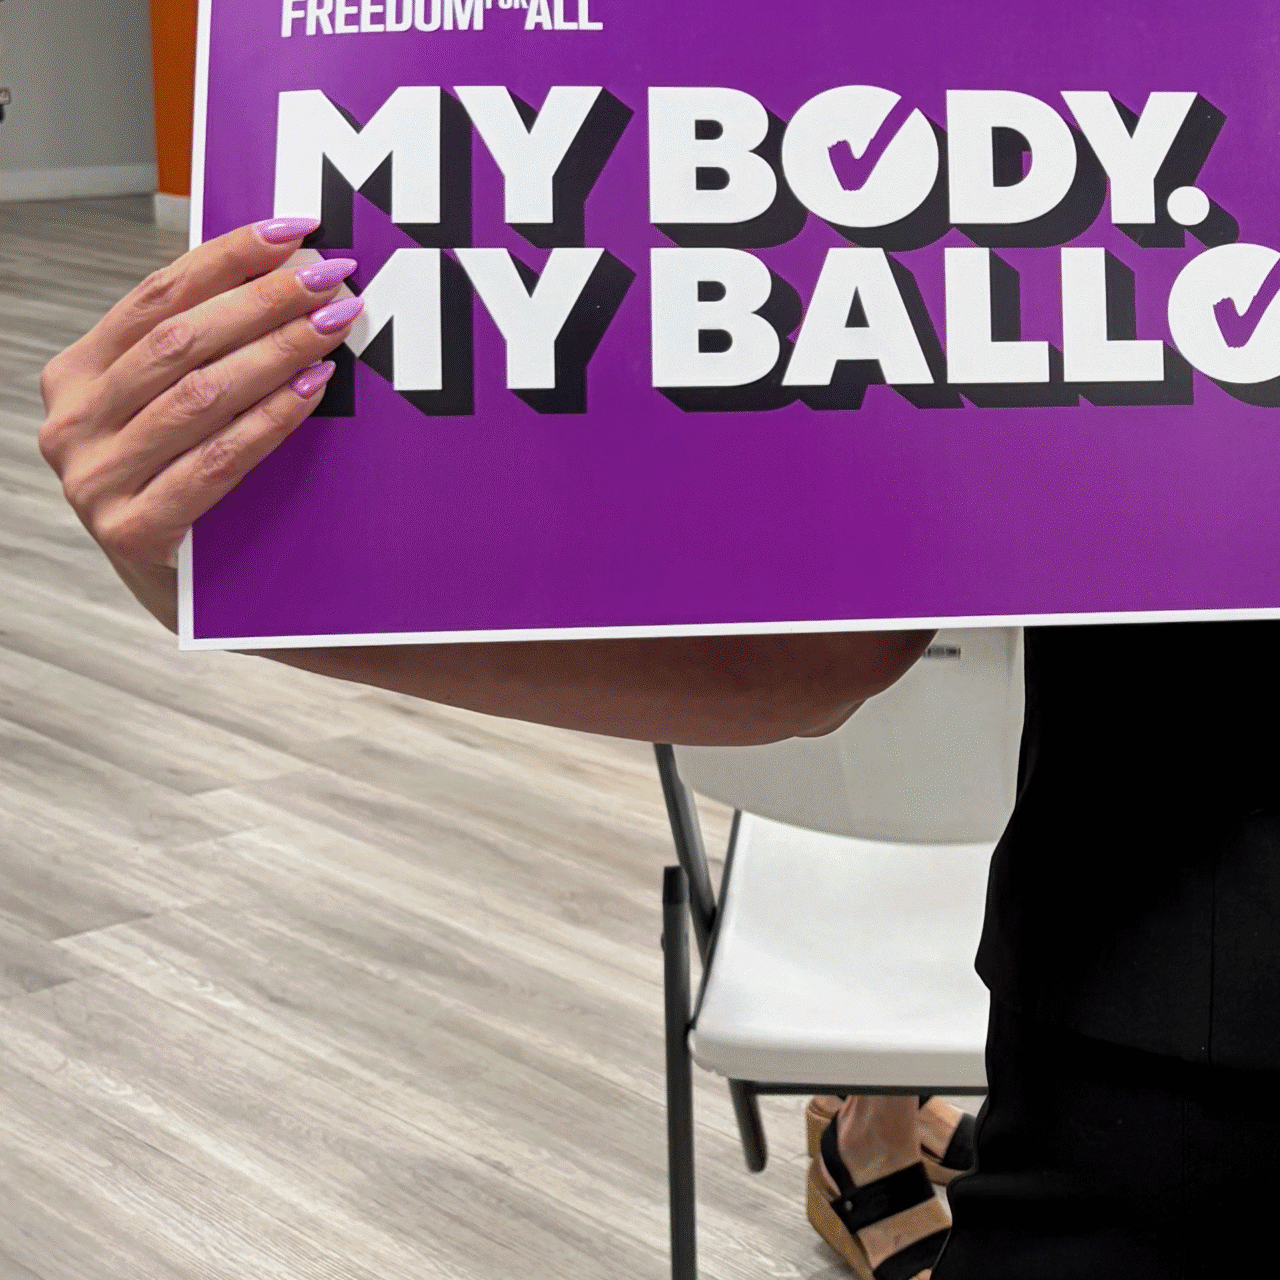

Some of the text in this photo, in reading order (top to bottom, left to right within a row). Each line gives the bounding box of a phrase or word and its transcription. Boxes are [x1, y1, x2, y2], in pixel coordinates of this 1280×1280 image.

[274, 85, 1210, 227] MY BODY.
[282, 248, 605, 390] MY
